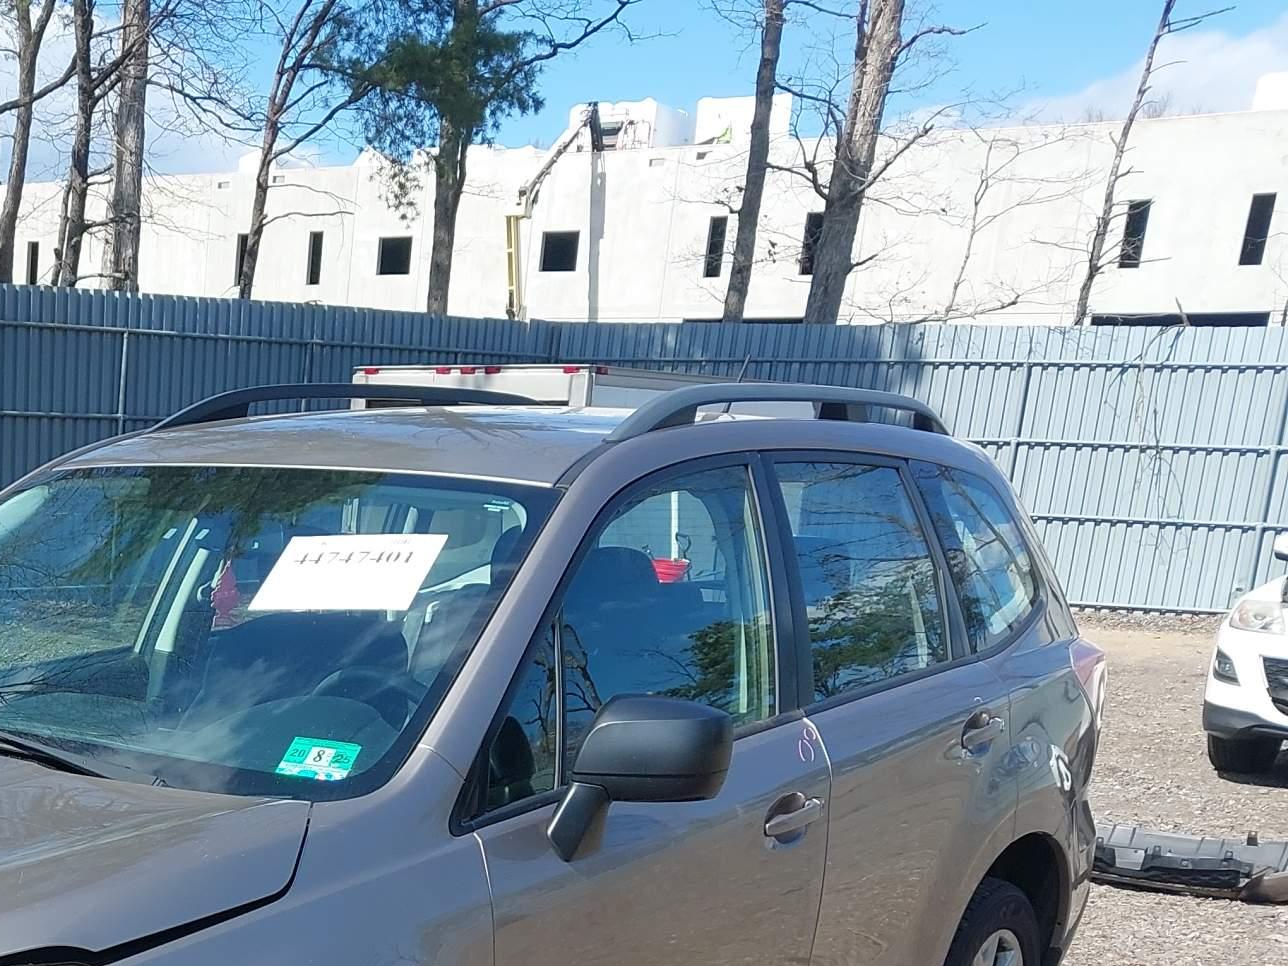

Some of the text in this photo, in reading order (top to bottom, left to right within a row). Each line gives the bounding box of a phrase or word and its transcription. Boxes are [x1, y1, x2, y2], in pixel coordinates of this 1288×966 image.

[294, 551, 414, 565] 44747401
[289, 749, 352, 764] 20 8 25
